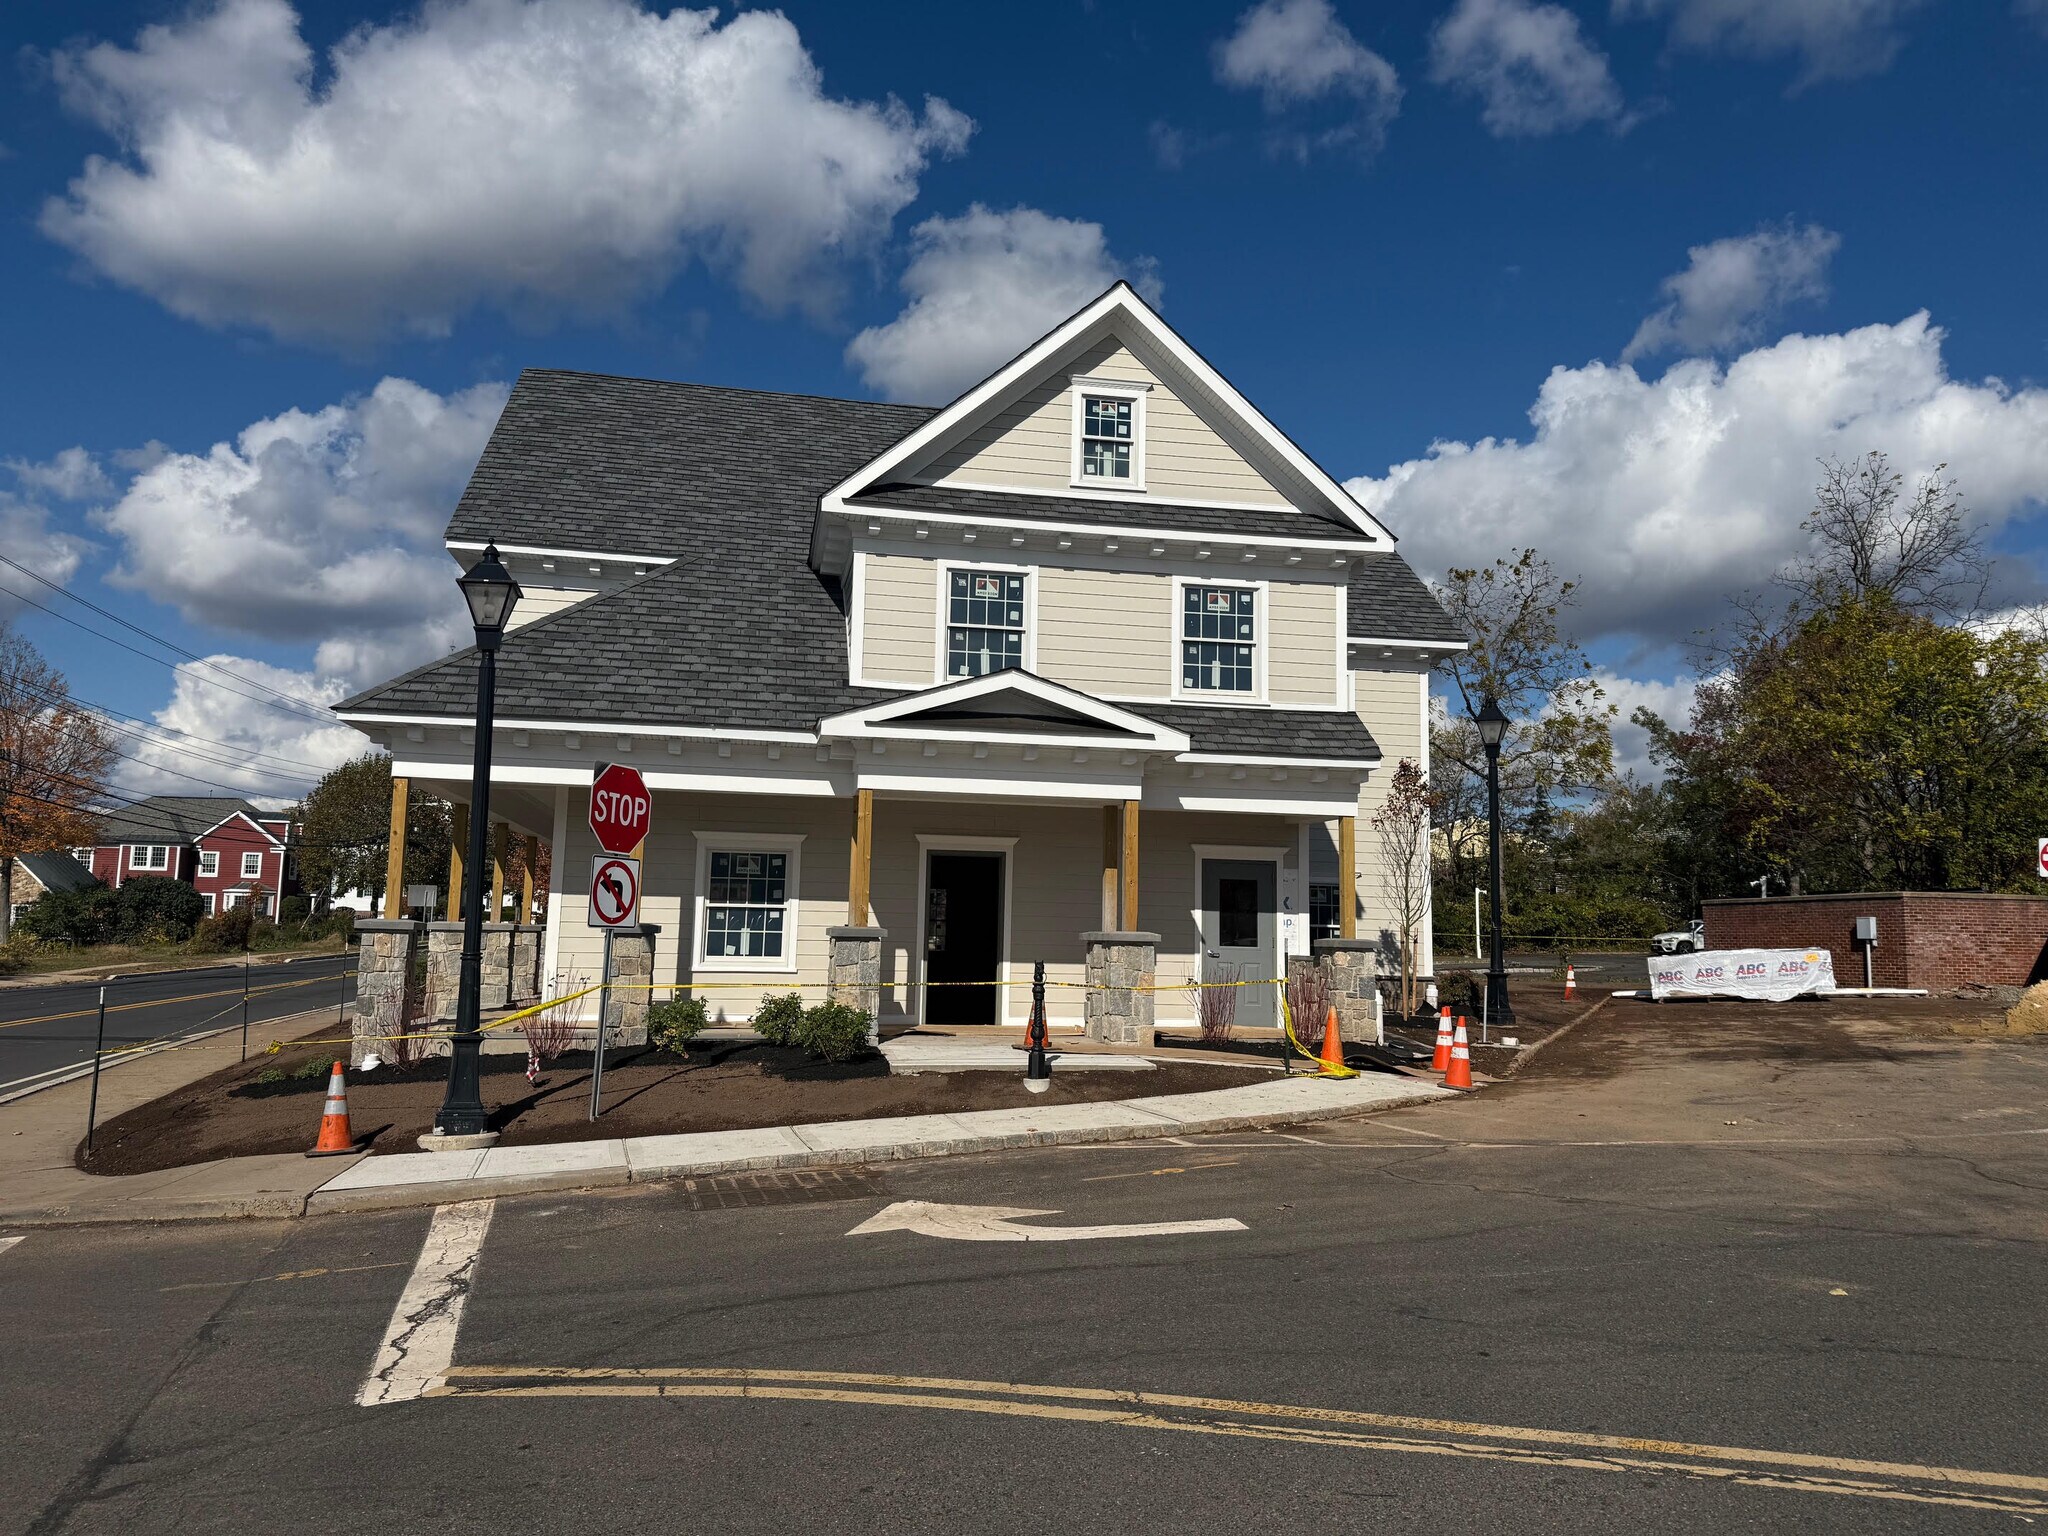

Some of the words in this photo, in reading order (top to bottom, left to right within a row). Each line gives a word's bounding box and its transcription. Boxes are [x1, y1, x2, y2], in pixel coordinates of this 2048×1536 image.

[594, 789, 647, 828] STOP
[1695, 966, 1724, 979] ABC
[1736, 962, 1767, 975] ABC
[1777, 960, 1809, 972] ABC
[1658, 970, 1684, 982] ABC
